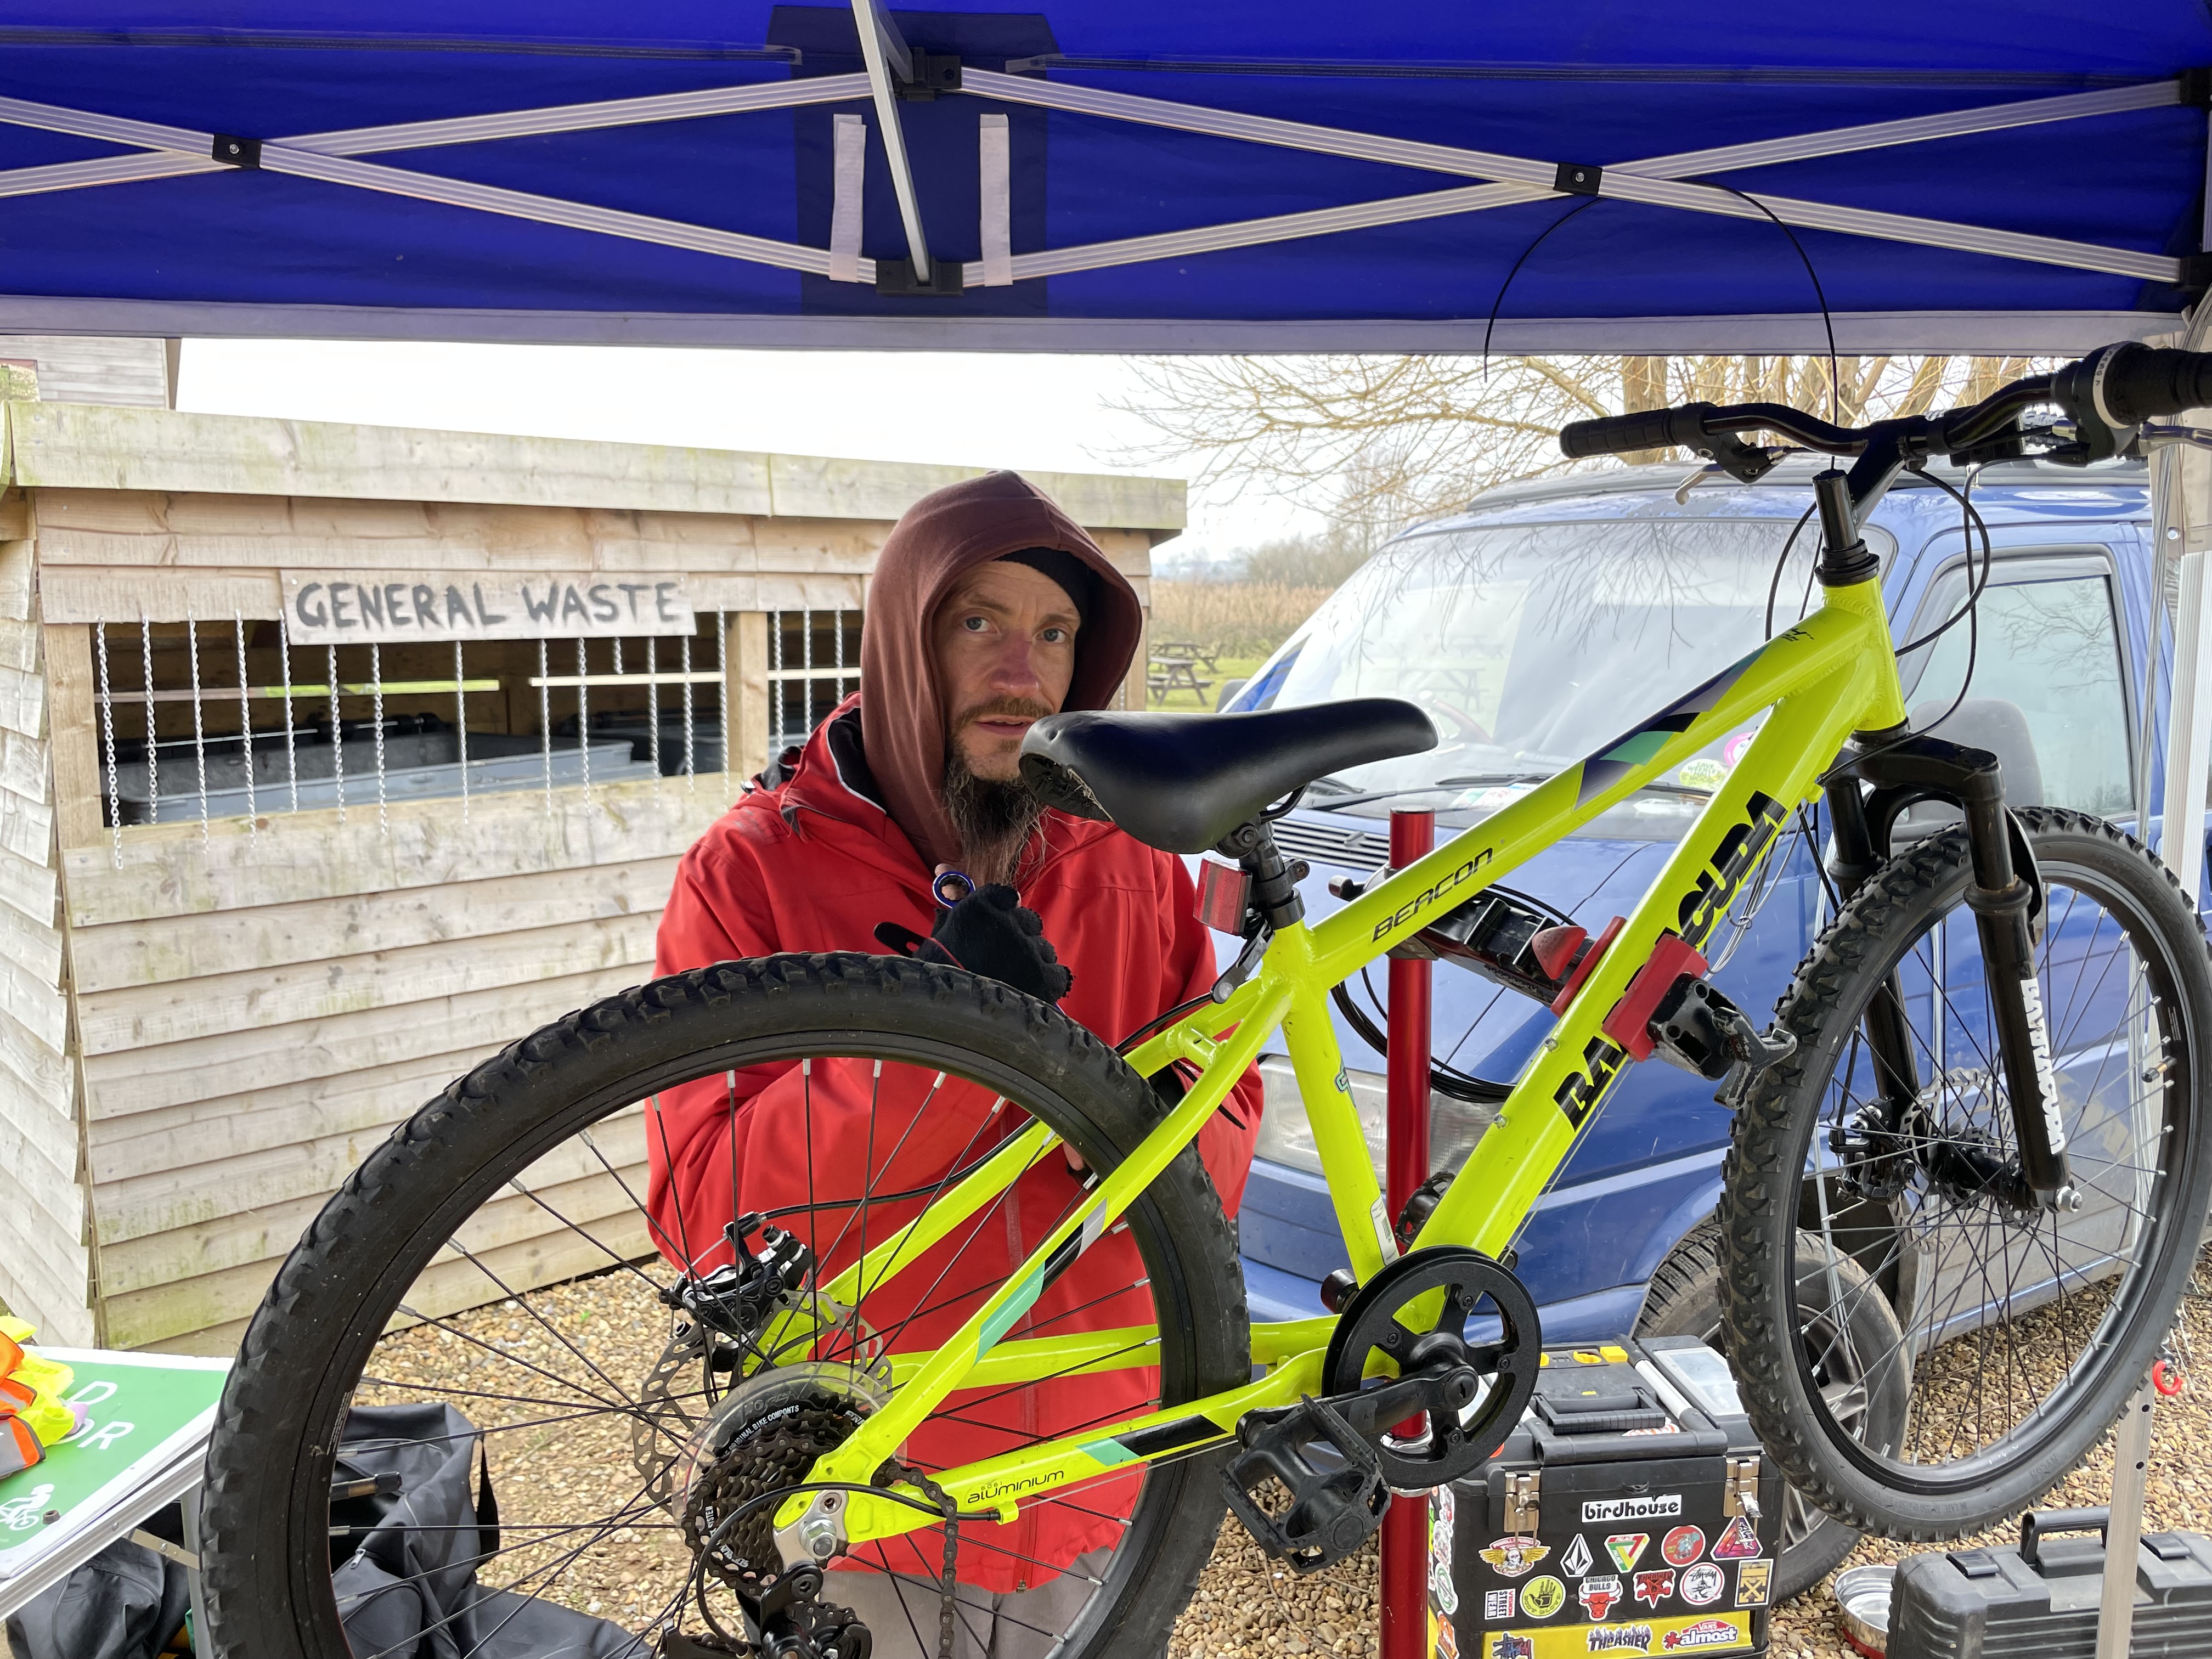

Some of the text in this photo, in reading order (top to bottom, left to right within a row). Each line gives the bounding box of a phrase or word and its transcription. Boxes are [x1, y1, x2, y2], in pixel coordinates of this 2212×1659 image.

[296, 582, 682, 631] GENERAL WASTE
[1372, 848, 1493, 943] BEACON
[754, 1417, 769, 1430] BIKE
[768, 1404, 800, 1422] COMPONTS
[968, 1470, 1064, 1504] aluminium
[1585, 1502, 1679, 1520] birdhouse
[1585, 1575, 1616, 1583] CHICAGO
[1589, 1583, 1611, 1591] BULLS
[1487, 1592, 1498, 1618] WEAR
[1499, 1591, 1508, 1616] STREET
[1680, 1627, 1738, 1646] almost
[1698, 1621, 1718, 1630] VANS
[1589, 1629, 1651, 1652] THRASHER
